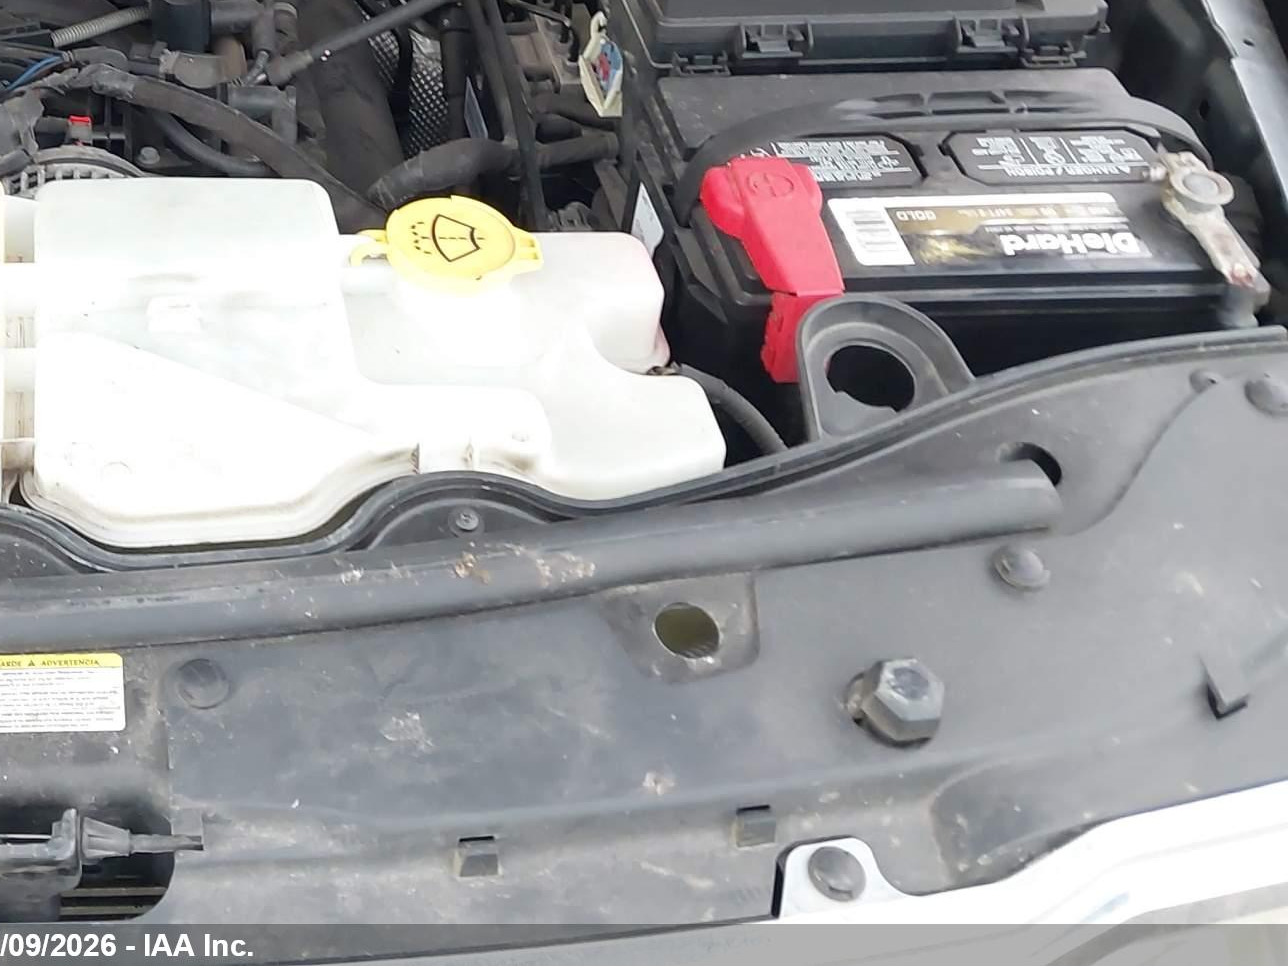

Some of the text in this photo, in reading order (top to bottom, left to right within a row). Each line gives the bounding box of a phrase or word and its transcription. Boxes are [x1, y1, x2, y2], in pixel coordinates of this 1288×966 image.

[1004, 166, 1056, 177] POISON
[1065, 165, 1119, 176] DANGER
[896, 209, 936, 222] GOLD
[1000, 232, 1140, 257] DieHard
[41, 659, 100, 667] ADVERTENCIA
